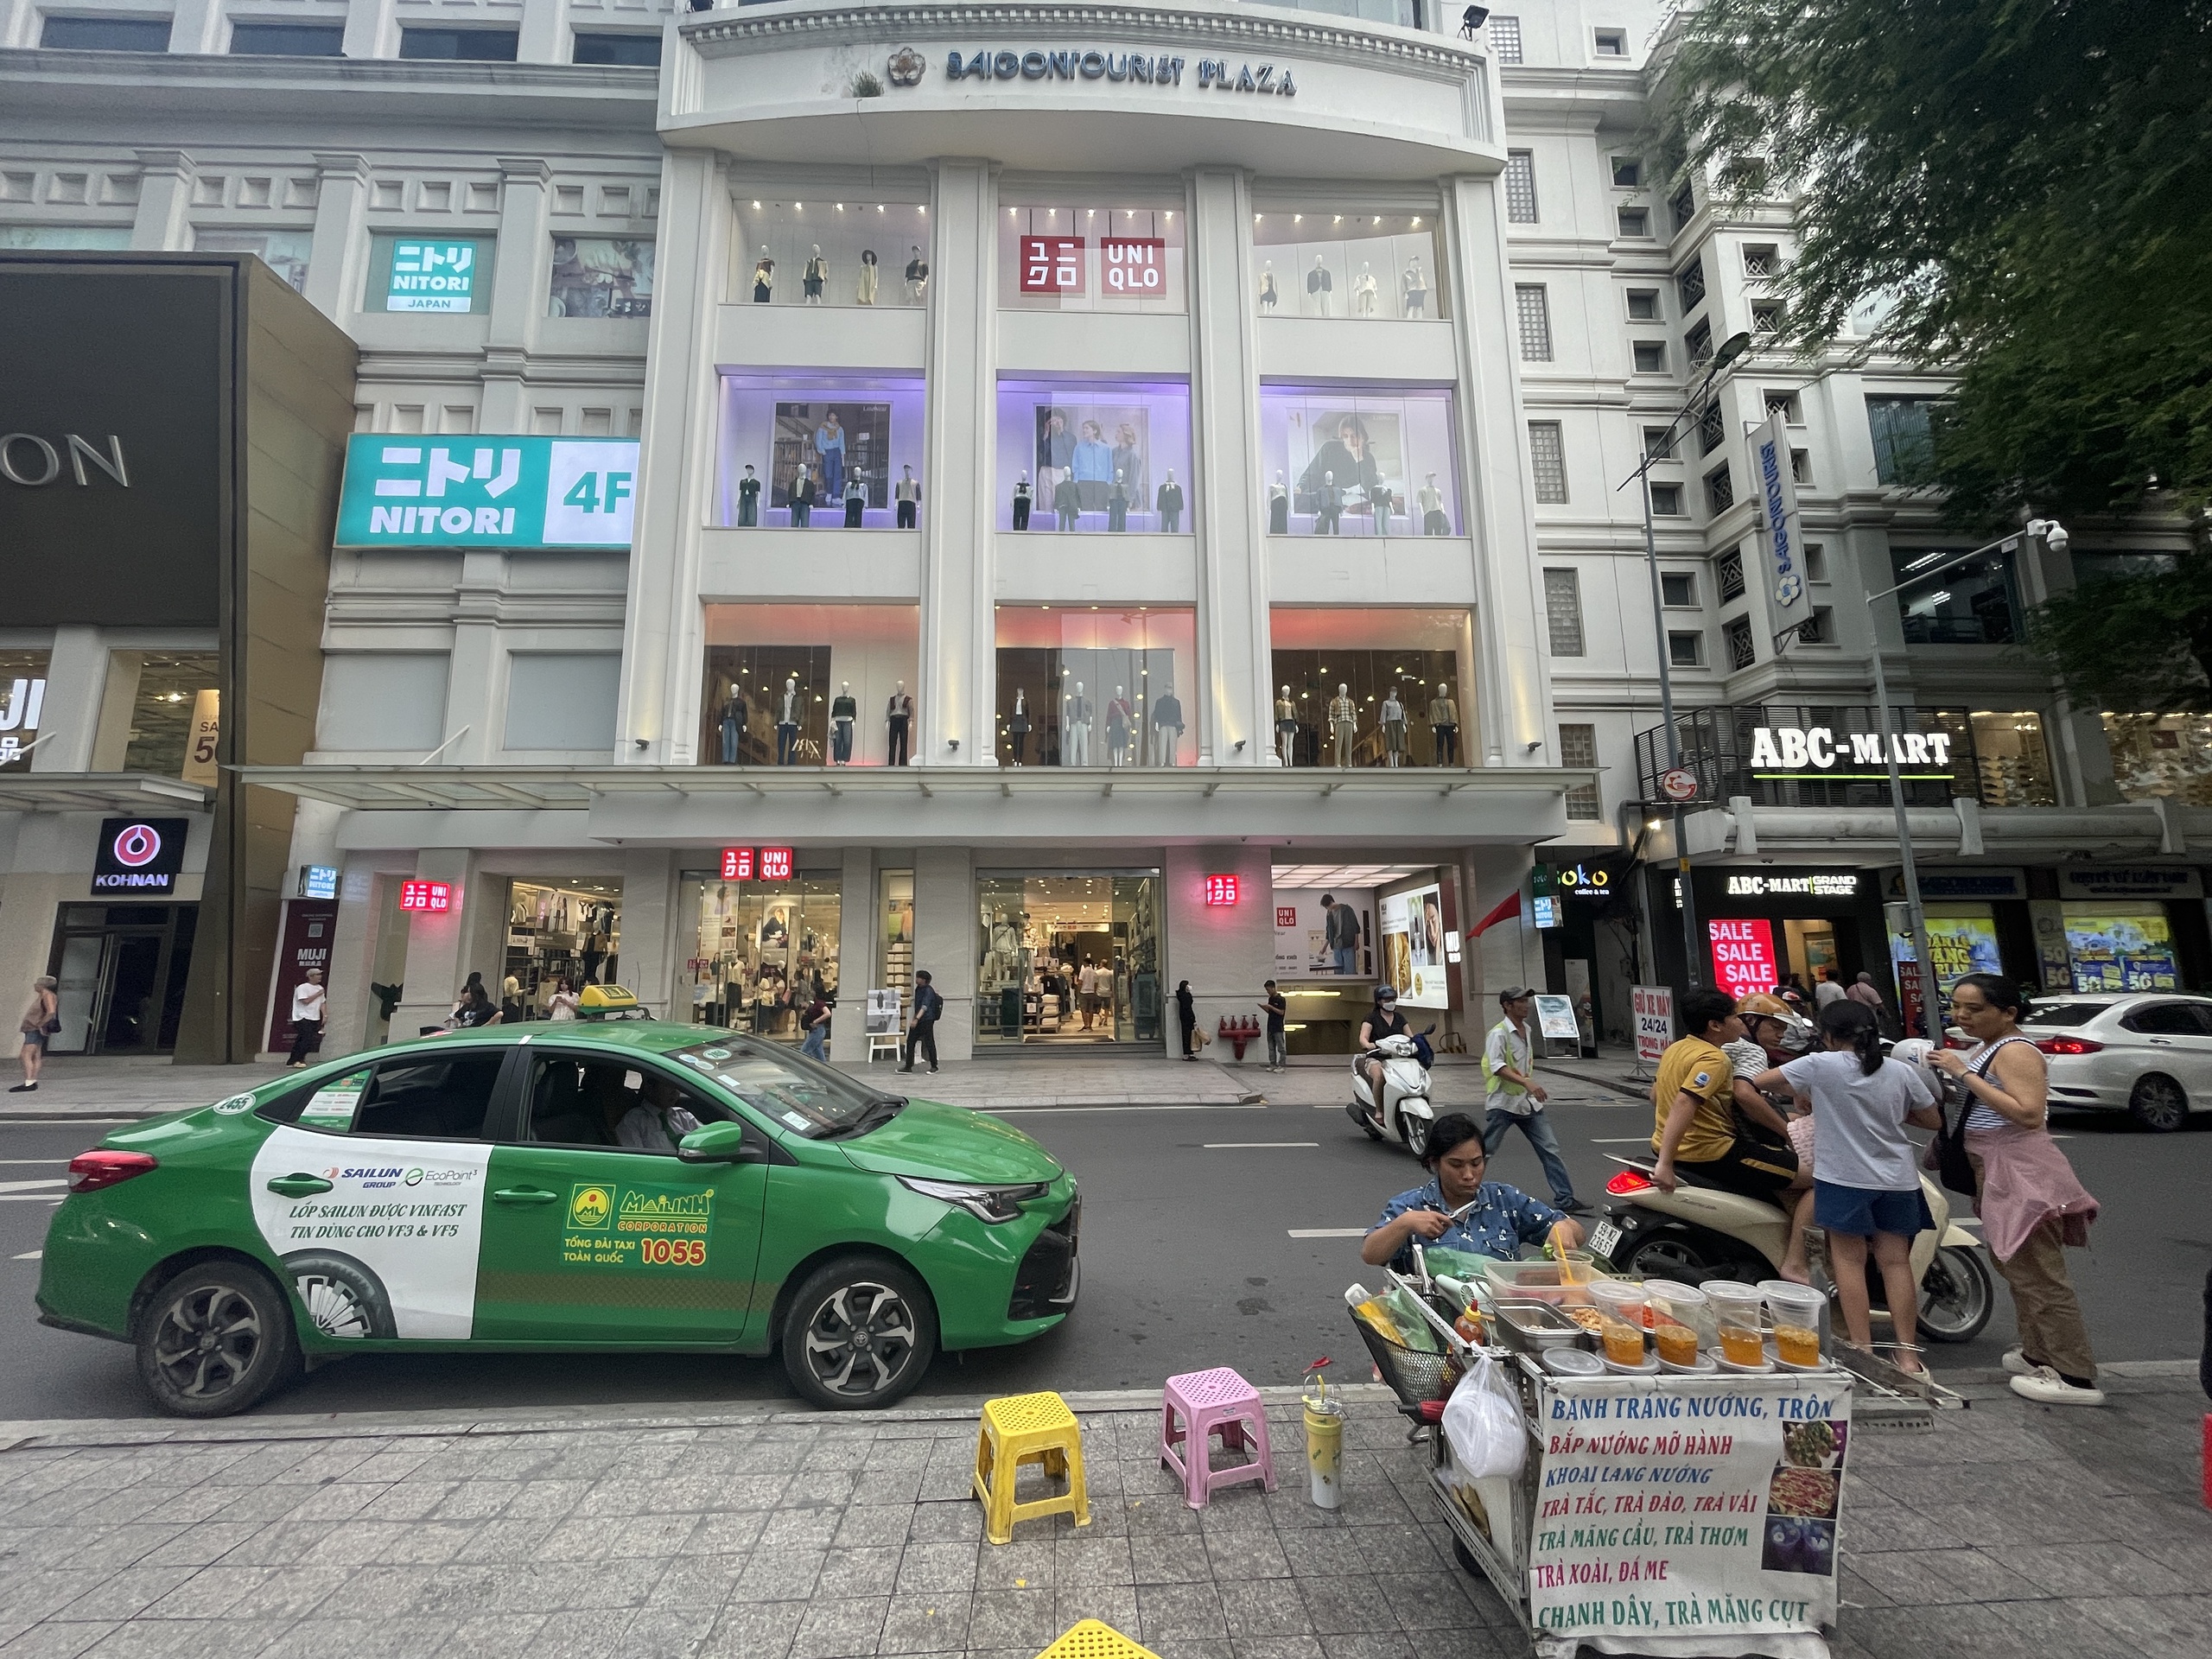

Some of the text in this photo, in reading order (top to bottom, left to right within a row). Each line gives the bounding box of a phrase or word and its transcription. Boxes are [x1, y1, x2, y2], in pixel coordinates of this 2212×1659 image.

[1198, 57, 1298, 96] PLAZA
[395, 245, 473, 273] ニトリ
[1108, 244, 1154, 264] UNI
[392, 275, 469, 291] NITORI
[1109, 267, 1159, 291] QLO
[408, 299, 451, 308] JAPAN
[374, 447, 522, 499] ニトリ
[563, 471, 632, 514] 4F
[369, 505, 516, 535] NITORI
[200, 721, 219, 733] SA
[194, 735, 219, 764] 5
[1751, 727, 1951, 768] ABC-MART
[763, 851, 787, 864] UNI
[95, 873, 169, 887] KOHNAN
[763, 864, 789, 878] QLO
[1727, 874, 1809, 896] ABC-MART
[1812, 875, 1857, 886] GRAND
[431, 886, 447, 897] UNI
[1814, 885, 1854, 895] STAGE
[430, 897, 447, 909] QLO
[1278, 917, 1294, 925] QLO
[1708, 923, 1754, 941] SALE
[296, 948, 327, 961] MUJI
[1716, 943, 1764, 962] SALE
[1725, 963, 1773, 982] SALE
[1900, 966, 1919, 977] SAL
[1904, 979, 1922, 991] SA
[1646, 994, 1656, 1016] XE
[1641, 1017, 1668, 1035] 24/24
[341, 1167, 404, 1179] SAILUN
[317, 1205, 370, 1218] SAILUN
[369, 1203, 409, 1221] ĐƯỢC
[409, 1204, 468, 1217] VINFAST
[289, 1225, 316, 1239] TIN
[356, 1224, 385, 1238] CHO
[387, 1224, 415, 1237] VF3
[416, 1224, 429, 1237] &
[431, 1224, 460, 1237] VF5
[617, 1220, 708, 1234] CORPORATION
[613, 1240, 635, 1250] TAXI
[641, 1237, 707, 1267] 1055
[563, 1249, 591, 1262] TOÀN
[1550, 1393, 1608, 1421] BÁNH
[1614, 1391, 1682, 1421] TRÁNG
[1586, 1430, 1649, 1456] NƯỚNG
[1683, 1427, 1733, 1456] HÀNH
[1545, 1462, 1714, 1488] KHOAI LANG NƯỚNG
[1541, 1491, 1570, 1519] TRÀ
[1613, 1490, 1644, 1514] TRÀ
[1648, 1491, 1688, 1514] ĐÀO,
[1538, 1524, 1566, 1552] TRÀ
[1663, 1520, 1694, 1546] TRÀ
[1699, 1526, 1749, 1547] THƠM
[1536, 1555, 1670, 1589] TRÀ XOÀI, ĐÁ ME
[1537, 1600, 1605, 1629] CHANH
[1611, 1593, 1660, 1629] DÂY,
[1664, 1592, 1702, 1625] TRÀ
[1707, 1592, 1764, 1624] MĂNG
